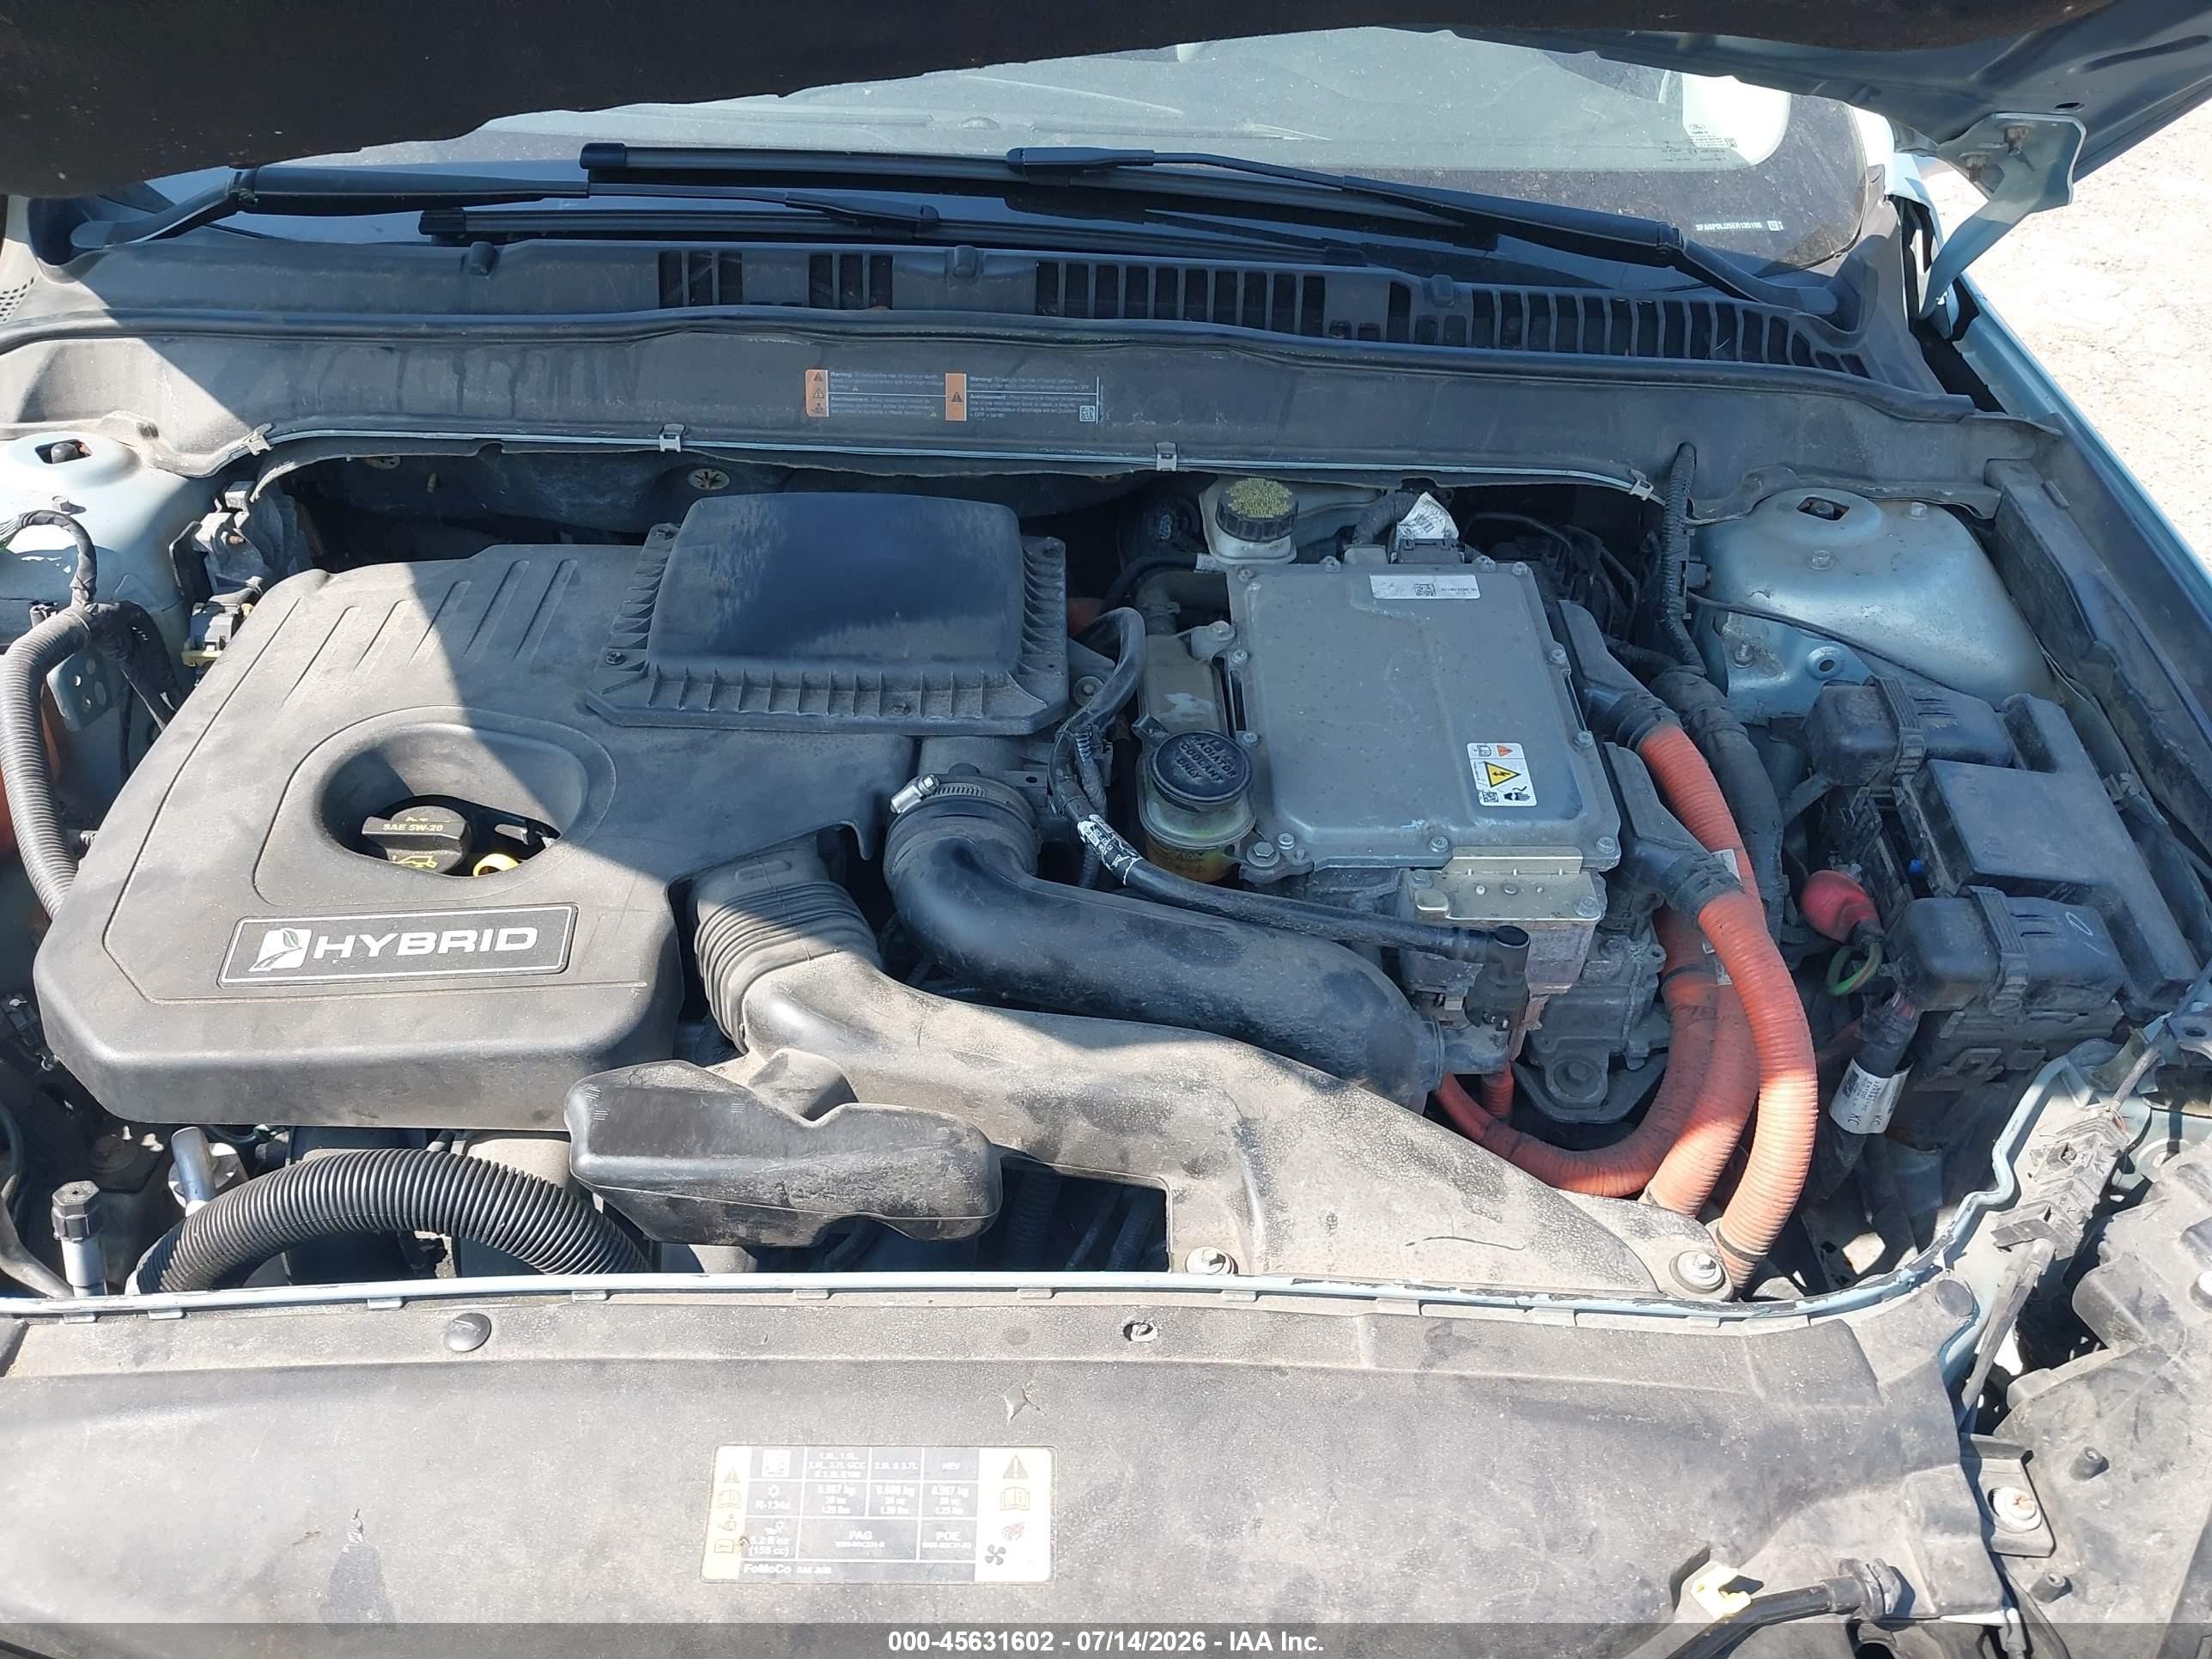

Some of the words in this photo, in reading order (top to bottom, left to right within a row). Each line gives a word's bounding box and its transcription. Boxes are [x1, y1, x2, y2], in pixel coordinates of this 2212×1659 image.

[1179, 742, 1224, 782] COOLANT
[1192, 736, 1237, 777] RADIATOR
[1176, 757, 1202, 780] ONLY
[382, 823, 407, 832] SAE
[408, 823, 444, 832] 5W-20
[313, 927, 539, 959] HYBRID
[843, 1484, 856, 1497] kg
[902, 1485, 915, 1498] kg
[957, 1485, 969, 1498] kg
[848, 1530, 873, 1540] PAG
[936, 1531, 962, 1541] POE
[744, 1563, 792, 1574] FoMoCo
